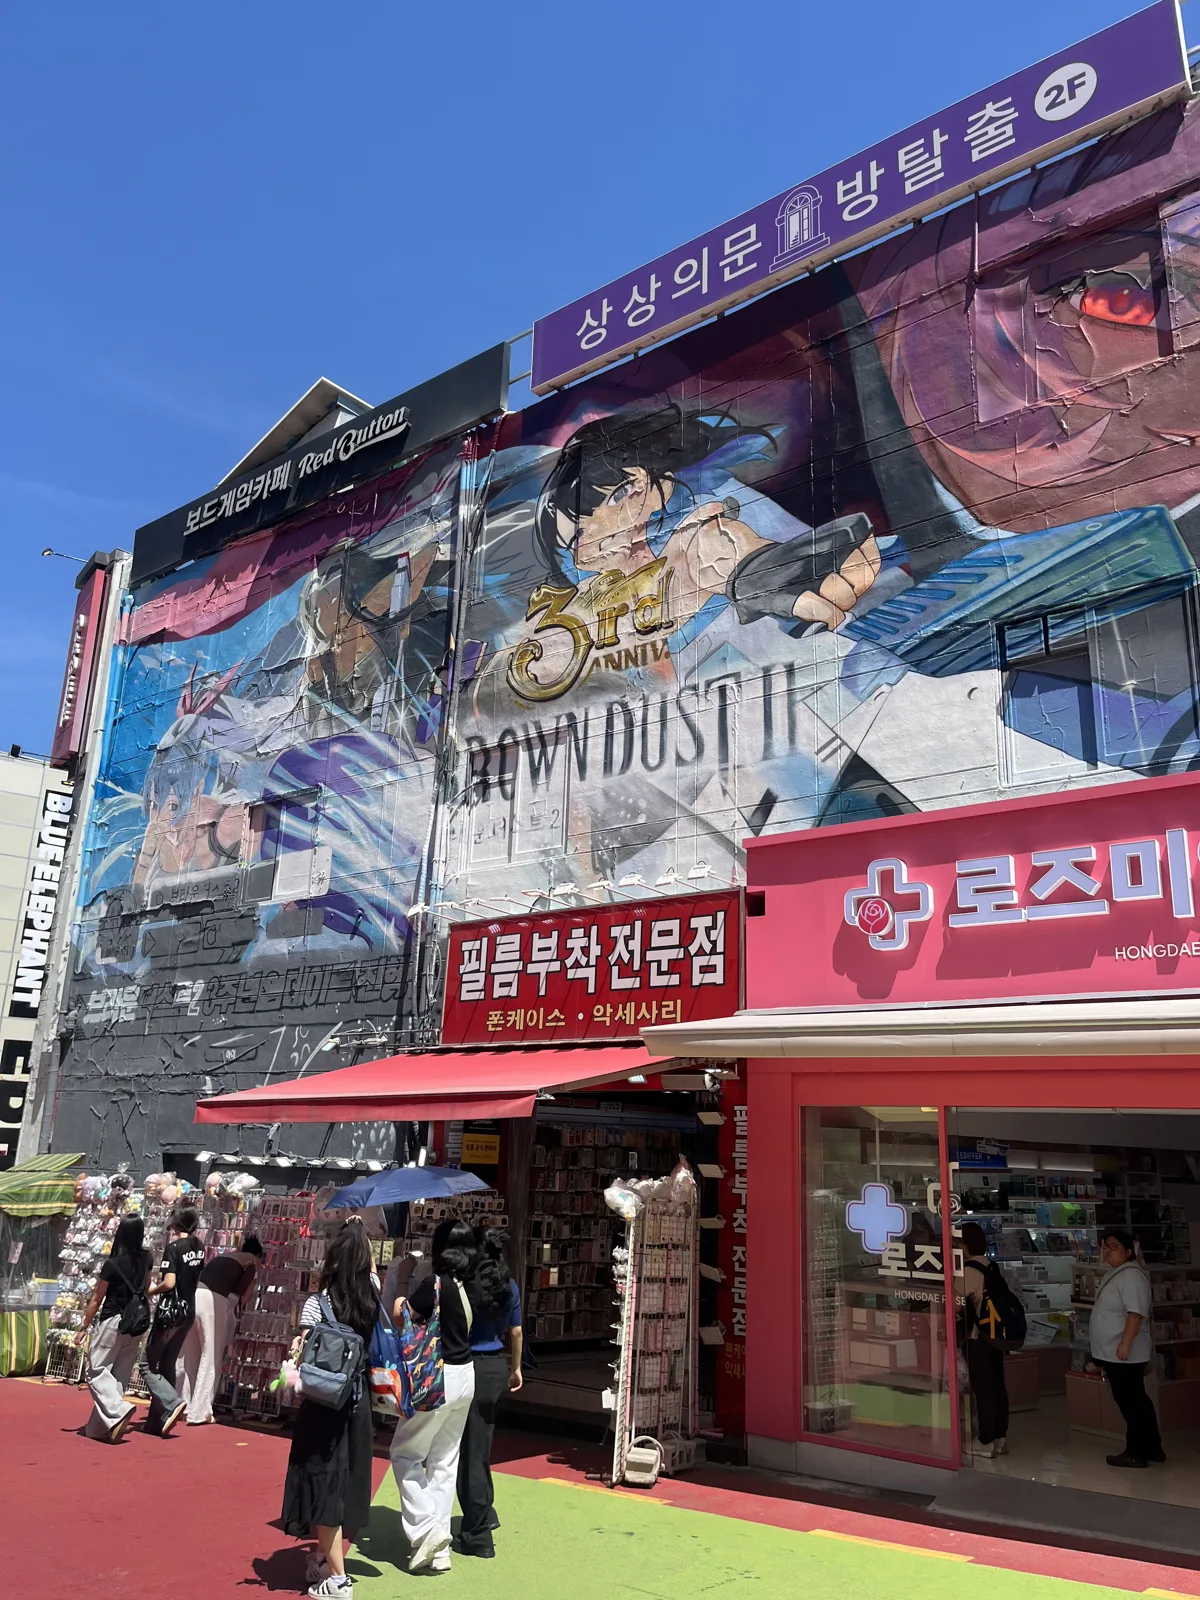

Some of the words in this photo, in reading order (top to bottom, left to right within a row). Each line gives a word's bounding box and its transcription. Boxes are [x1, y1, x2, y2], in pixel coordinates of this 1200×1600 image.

[836, 96, 1019, 222] 방탈출
[1043, 72, 1090, 113] 2F
[183, 460, 293, 536] 보드게임카페
[37, 792, 73, 862] BLUE
[948, 828, 1200, 928] 로즈미
[11, 863, 61, 1008] ELEPHANT
[486, 1007, 566, 1032] 폰케이스
[593, 999, 682, 1026] 악세사리
[894, 1289, 940, 1303] HONGDAE
